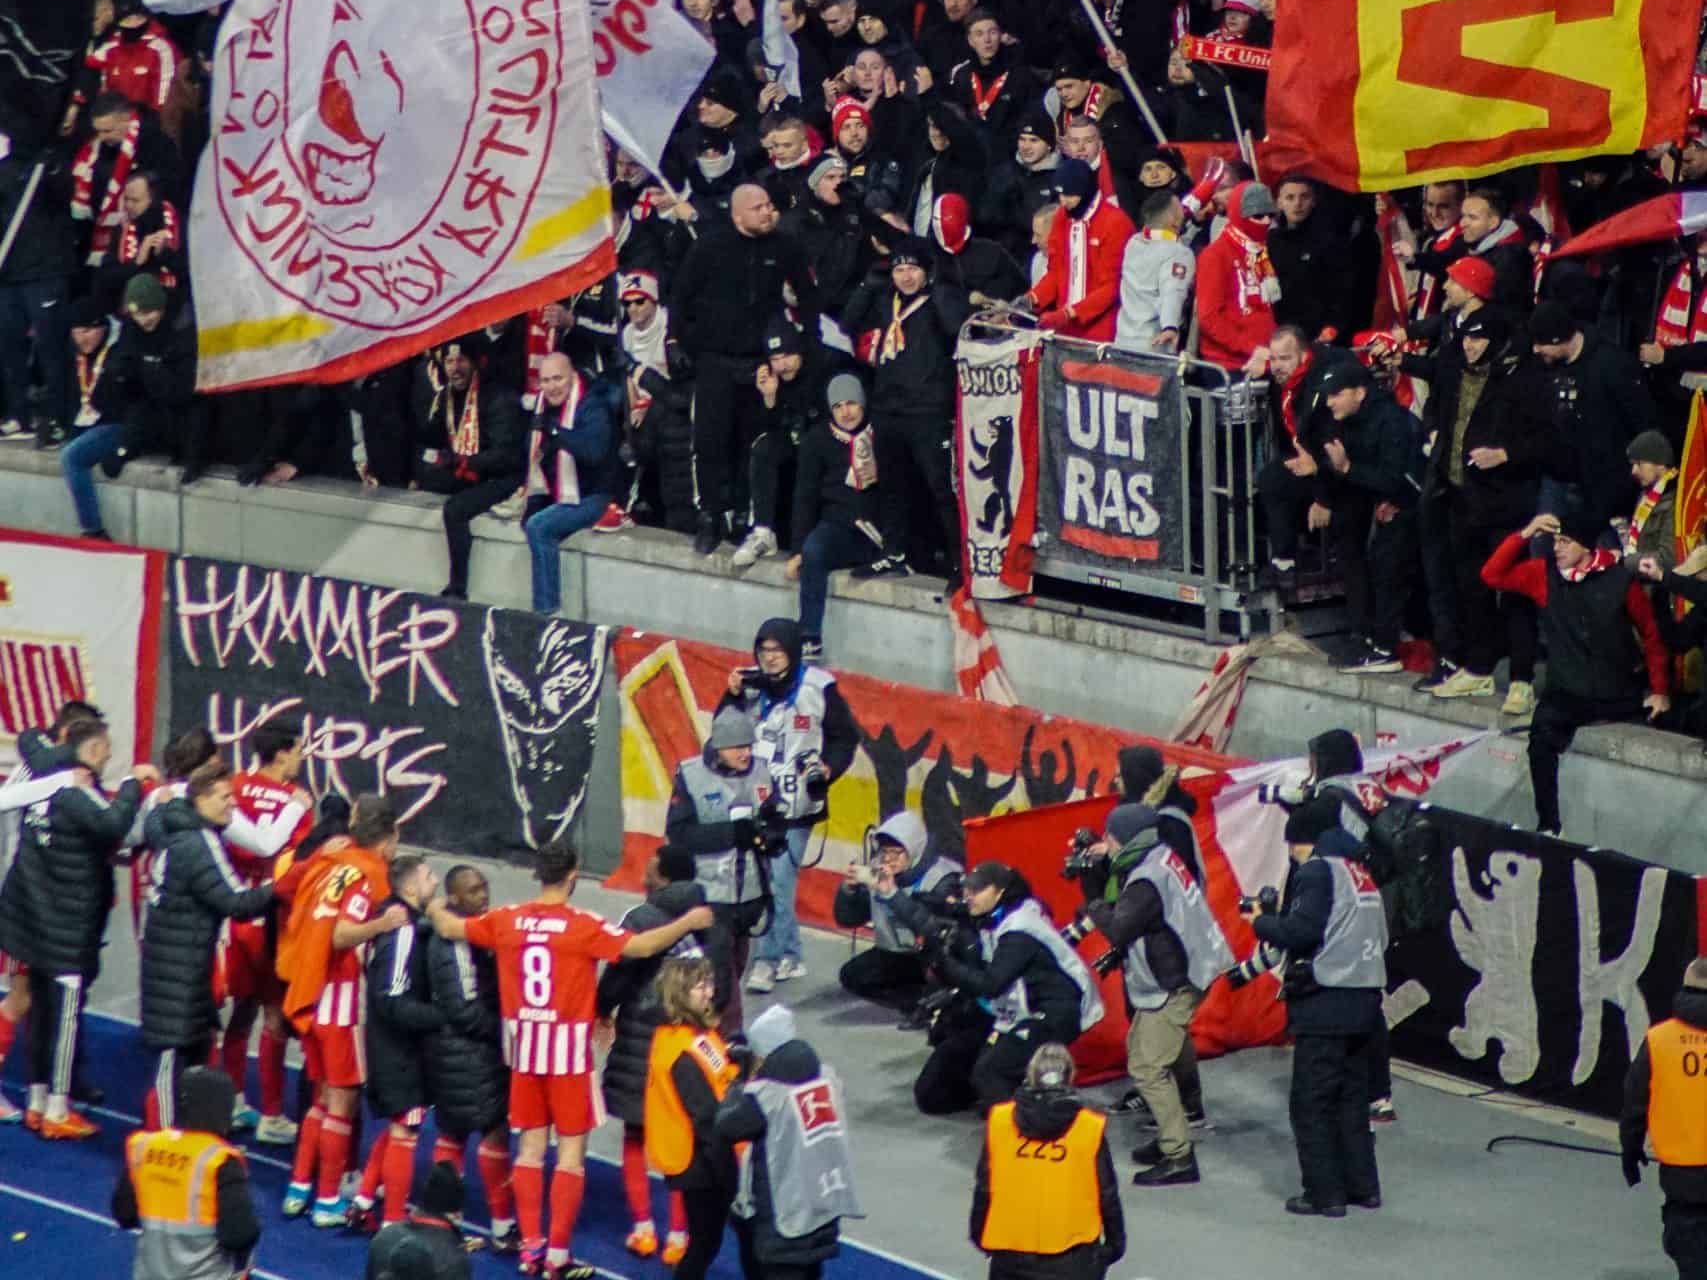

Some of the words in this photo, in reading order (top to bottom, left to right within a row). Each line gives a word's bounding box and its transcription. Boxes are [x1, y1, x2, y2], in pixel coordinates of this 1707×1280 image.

[1214, 47, 1234, 61] FC
[1064, 383, 1160, 462] ULT
[1063, 455, 1161, 537] RAS
[175, 558, 460, 707] HAMMER
[0, 639, 86, 738] ION
[209, 691, 449, 824] HRTS
[523, 945, 551, 1008] 8
[1682, 1051, 1707, 1078] 0
